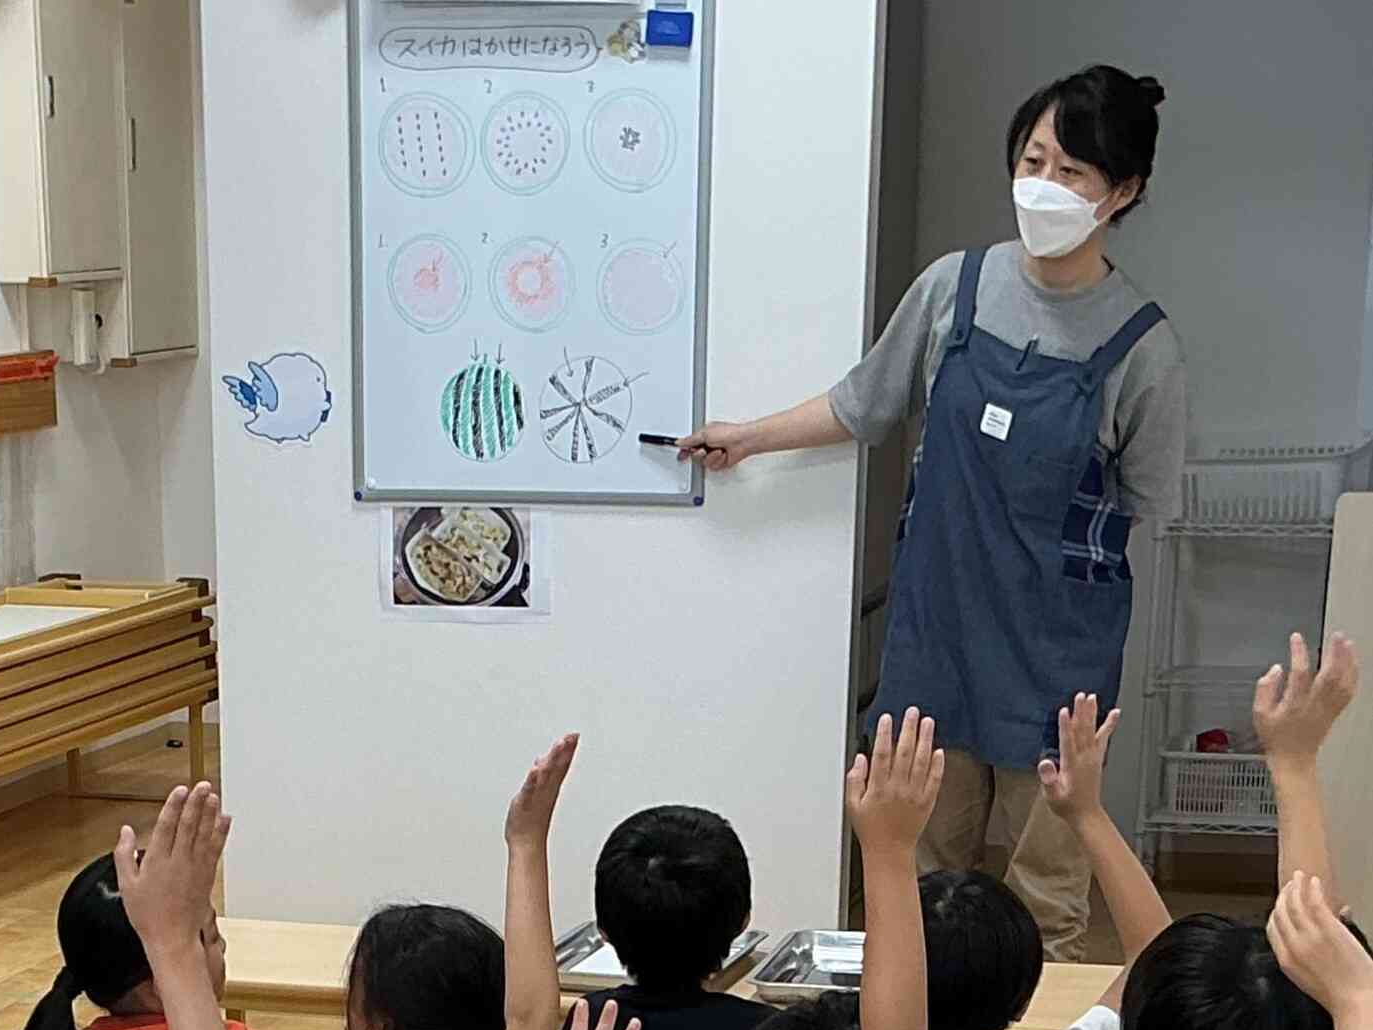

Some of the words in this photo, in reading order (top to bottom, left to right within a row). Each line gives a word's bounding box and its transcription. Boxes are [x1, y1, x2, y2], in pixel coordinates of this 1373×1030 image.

[393, 33, 590, 59] スイカはかせになろう
[599, 232, 609, 249] 3
